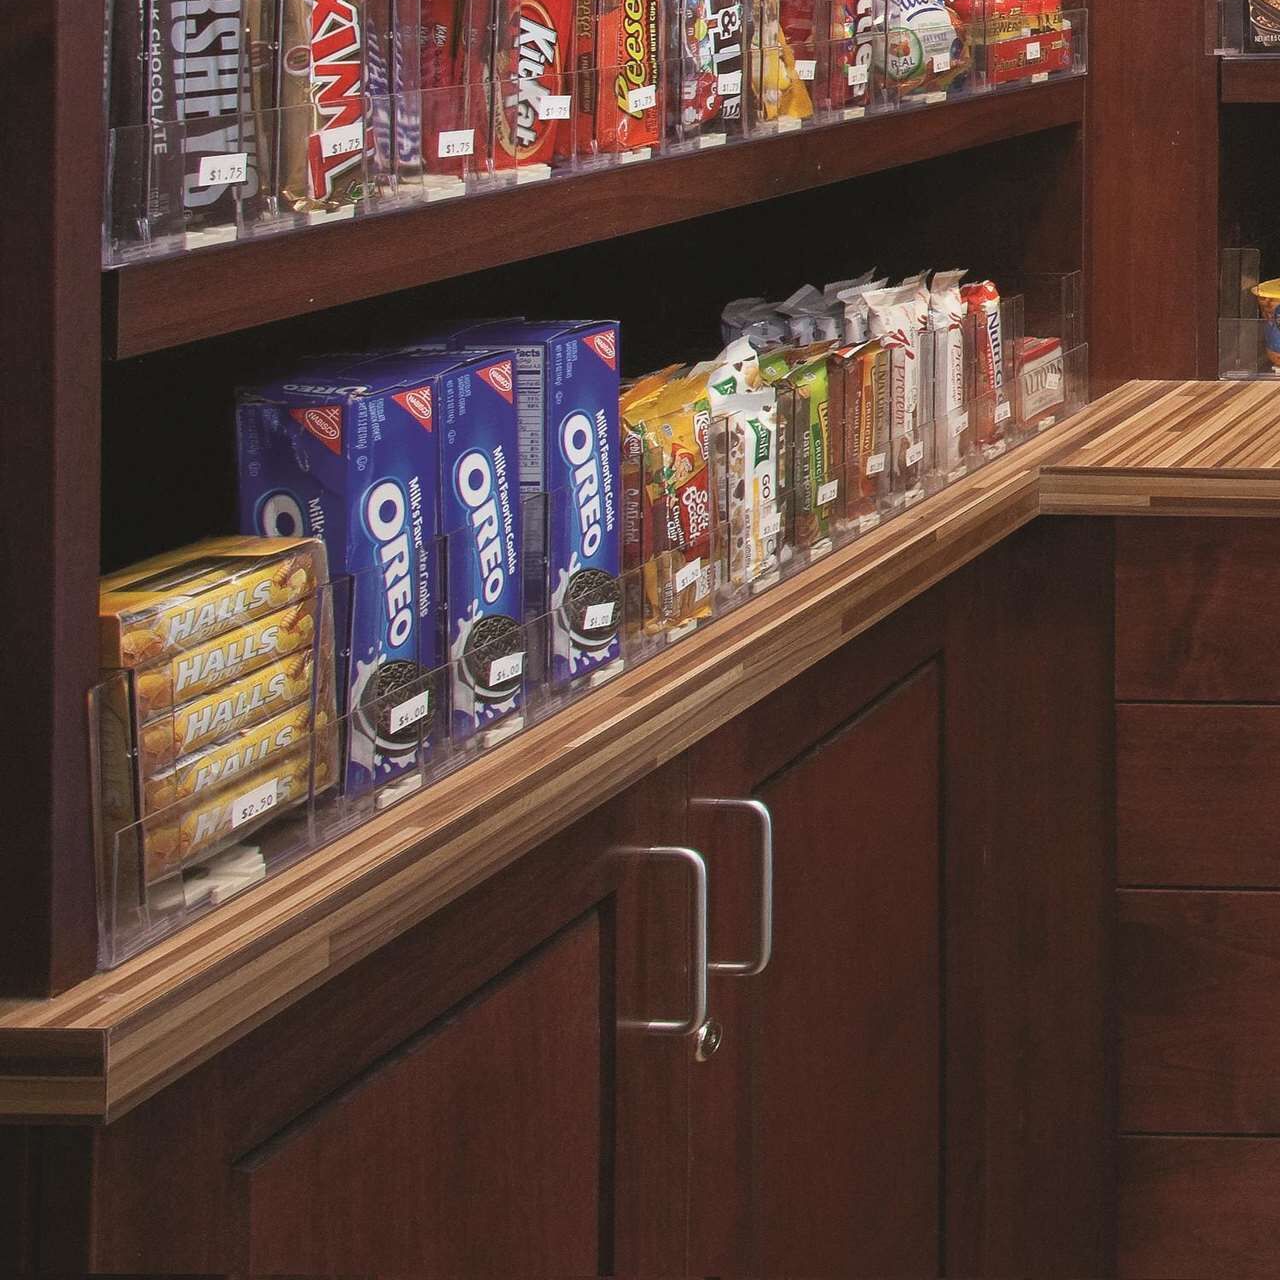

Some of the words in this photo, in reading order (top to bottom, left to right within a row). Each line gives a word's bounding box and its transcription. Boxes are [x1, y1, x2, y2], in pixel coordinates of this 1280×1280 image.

[152, 33, 167, 155] CHOCOLATE
[634, 97, 653, 107] $1.75
[332, 139, 360, 154] $1.75
[444, 142, 471, 154] $1.75
[209, 168, 243, 181] $1.75
[560, 411, 603, 560] OREO
[456, 451, 505, 605] OREO
[696, 487, 709, 531] Soft
[365, 480, 414, 649] OREO
[164, 579, 272, 647] HALLS
[175, 625, 280, 694] HALLS
[497, 664, 520, 680] $4.00
[182, 674, 288, 746] HALLS
[397, 703, 426, 725] $4.00
[241, 793, 274, 820] $2.50
